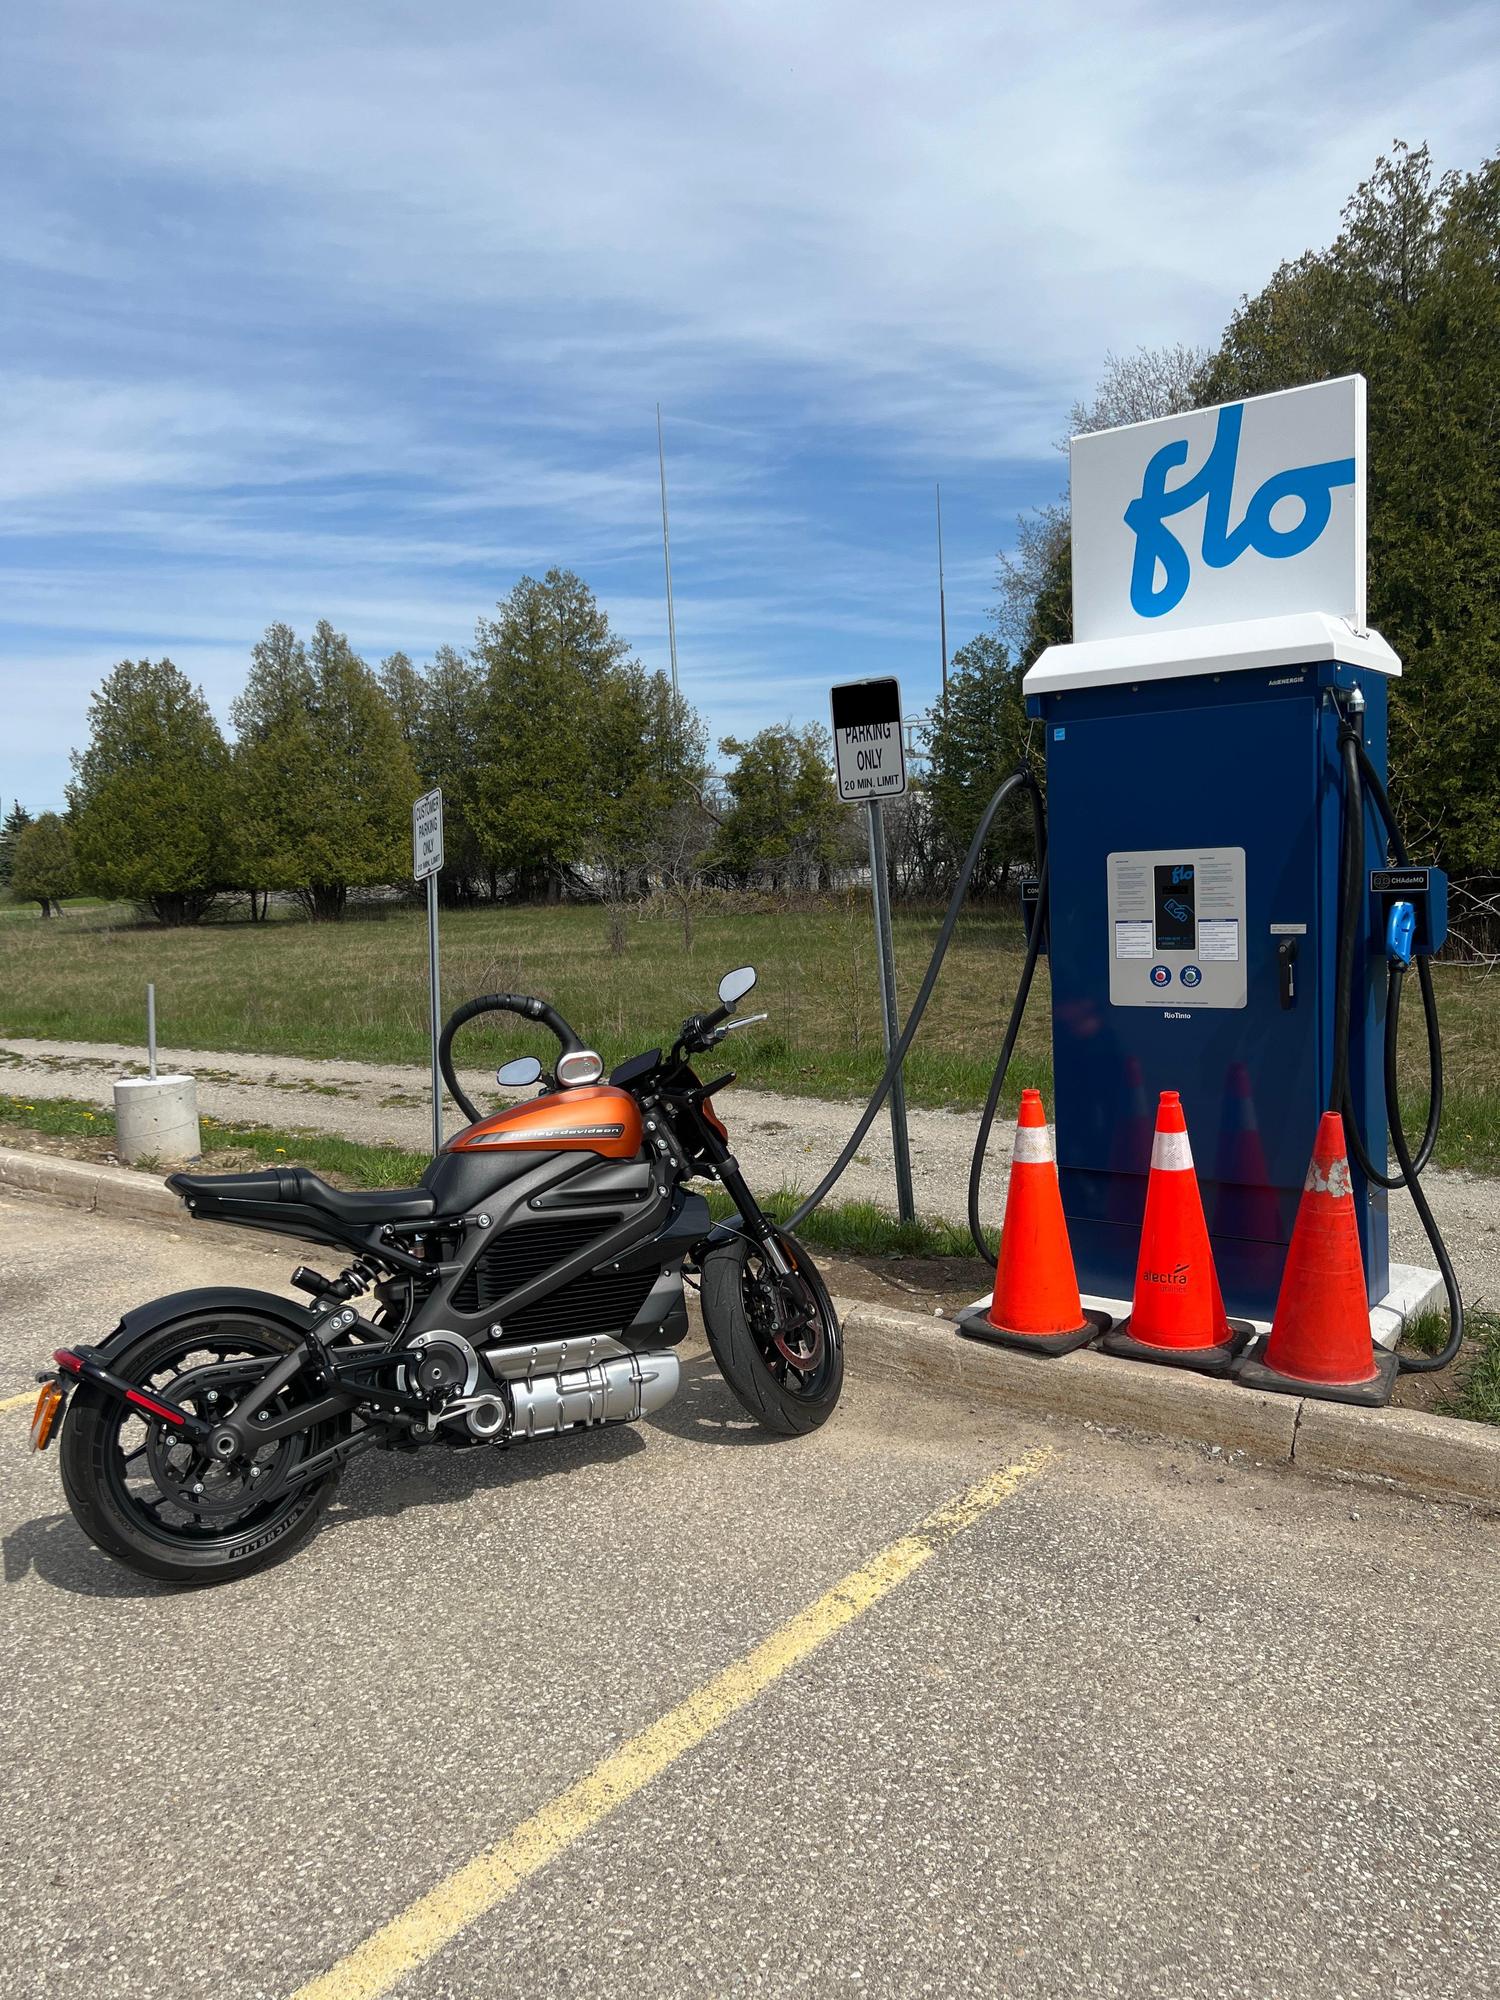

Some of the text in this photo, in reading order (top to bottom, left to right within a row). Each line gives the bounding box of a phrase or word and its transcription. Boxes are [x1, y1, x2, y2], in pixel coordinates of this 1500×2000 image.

[1124, 404, 1355, 618] flo
[845, 723, 891, 744] PARKING
[857, 748, 883, 771] ONLY
[844, 774, 899, 791] 20 MIN. LIMIT
[416, 796, 439, 821] CUSTOMER
[418, 817, 438, 839] PARKING
[423, 838, 434, 856] ONLY
[1172, 865, 1195, 884] flo
[1391, 876, 1424, 884] CHAdeMO
[511, 1127, 619, 1137] harley-davidson
[1143, 1271, 1187, 1285] alectra
[230, 1508, 302, 1558] MICHELIN
